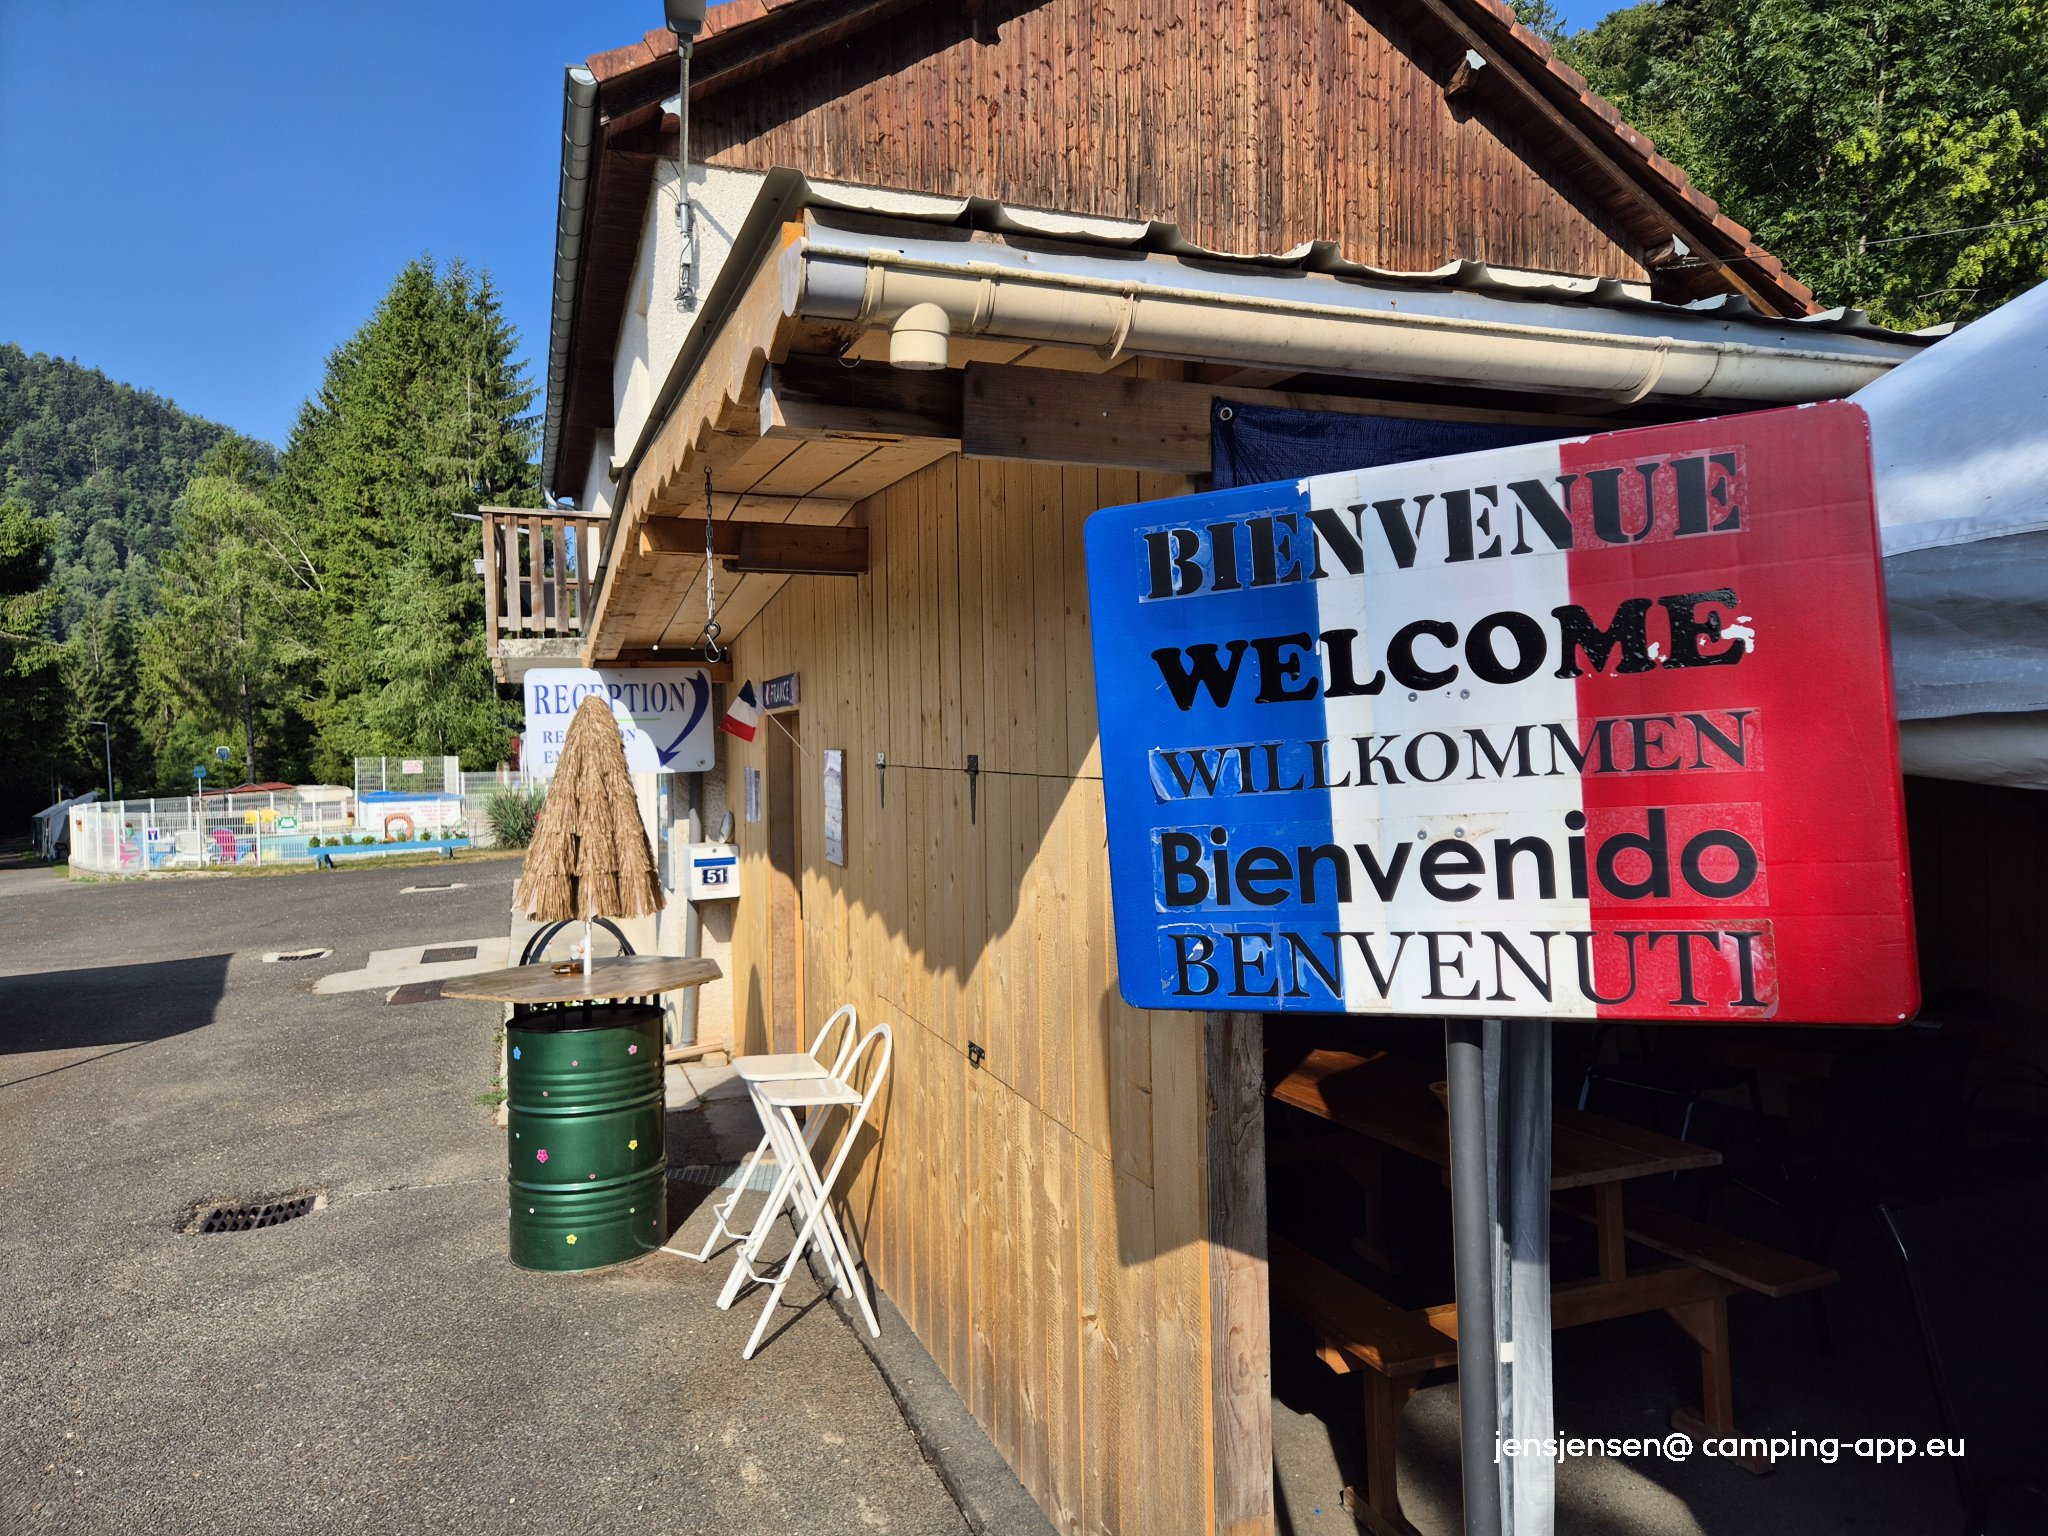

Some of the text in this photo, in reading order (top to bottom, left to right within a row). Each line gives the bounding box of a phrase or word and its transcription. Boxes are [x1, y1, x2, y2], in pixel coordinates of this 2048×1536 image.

[1143, 452, 1742, 600] BIENVENUE
[1151, 588, 1749, 711] WELCOME
[1161, 710, 1752, 798] WILLKOMMEN
[707, 869, 724, 883] 51
[1163, 809, 1758, 907] Bienvenido
[1168, 930, 1771, 1008] BENVENUTI
